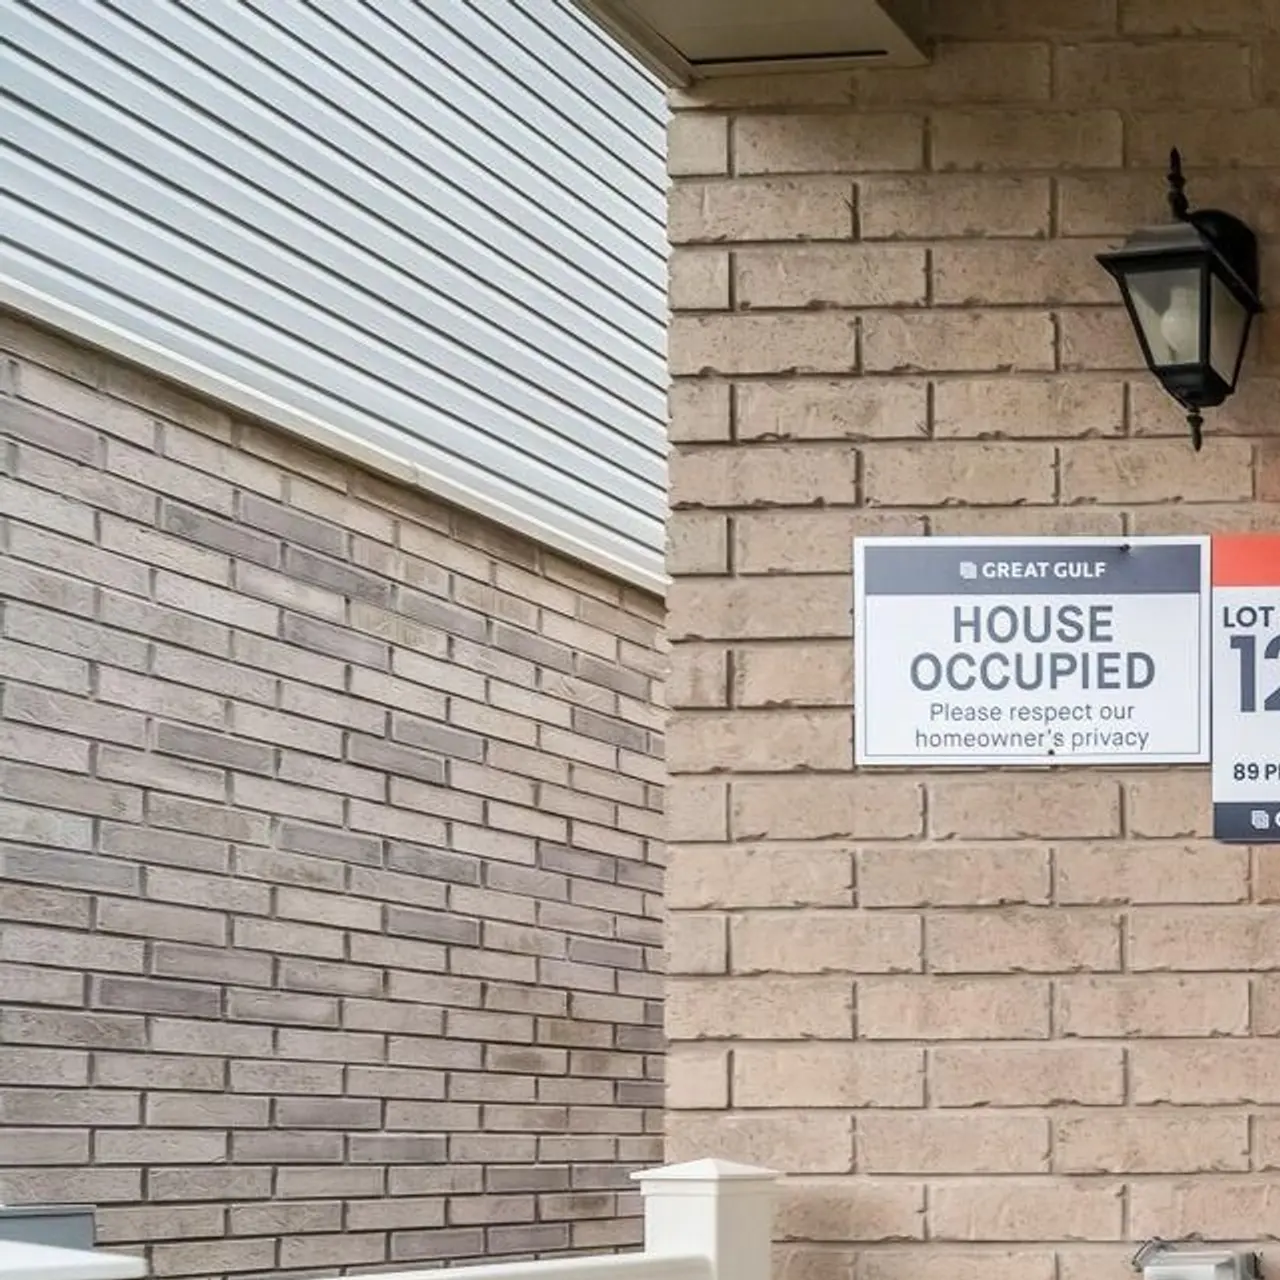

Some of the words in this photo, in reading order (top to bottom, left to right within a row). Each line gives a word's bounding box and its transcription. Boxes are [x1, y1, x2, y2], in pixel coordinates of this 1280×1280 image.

[982, 561, 1050, 579] GREAT
[1053, 561, 1106, 579] GULF
[953, 605, 1114, 644] HOUSE
[1223, 606, 1275, 628] LOT
[910, 651, 1156, 692] OCCUPIED
[930, 702, 1003, 722] Please
[1009, 703, 1093, 725] respect
[1099, 705, 1136, 721] our
[915, 728, 1065, 748] homeowner's
[1071, 727, 1150, 752] privacy
[1233, 762, 1260, 781] 89
